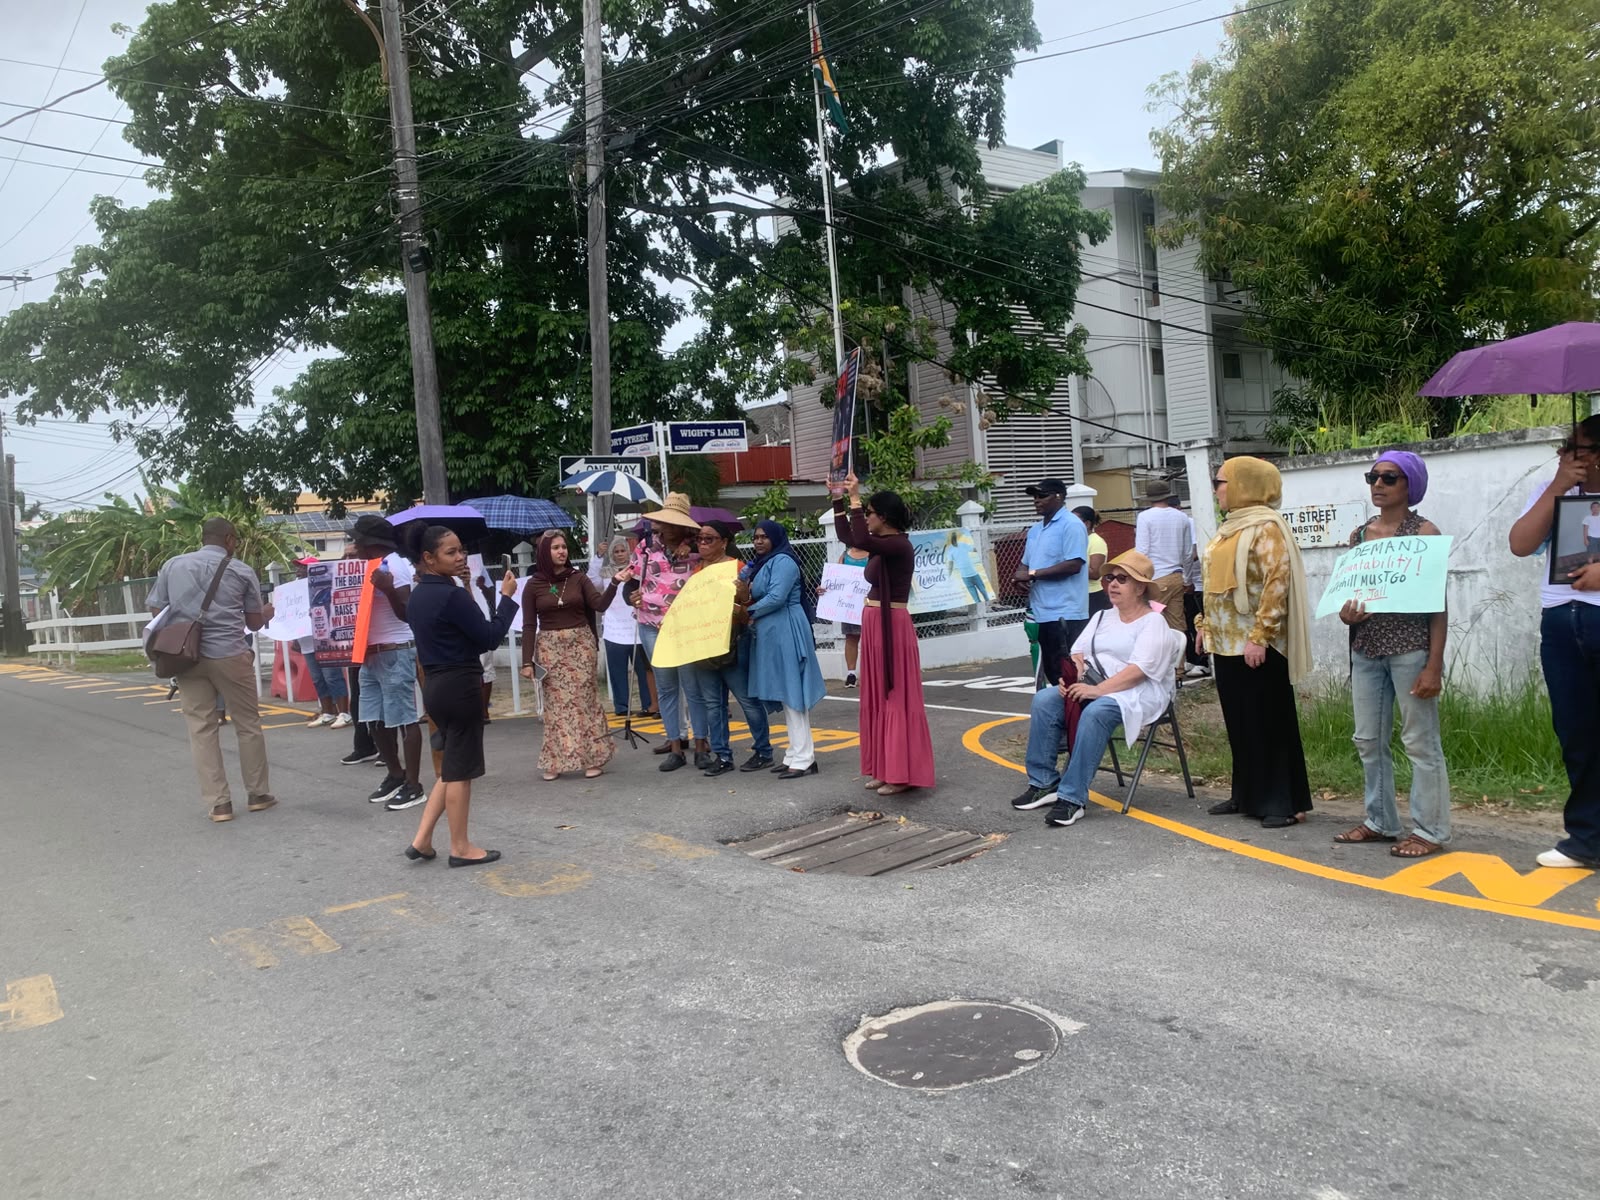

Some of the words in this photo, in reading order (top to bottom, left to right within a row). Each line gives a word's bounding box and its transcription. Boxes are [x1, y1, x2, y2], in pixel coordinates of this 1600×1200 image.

[680, 428, 716, 438] WIGHT'S
[717, 428, 740, 437] LANE
[610, 437, 622, 447] ORT
[623, 433, 649, 445] STREET
[613, 464, 637, 475] WAY
[1299, 508, 1337, 524] STREET
[1292, 525, 1325, 534] NGSTON
[1310, 535, 1322, 543] 32
[1352, 537, 1429, 559] DEMAND
[338, 561, 366, 576] FLOAT
[335, 577, 347, 588] THE
[348, 575, 365, 587] BOAT
[917, 569, 947, 587] Words
[335, 603, 353, 615] RAISE
[332, 616, 342, 627] MV
